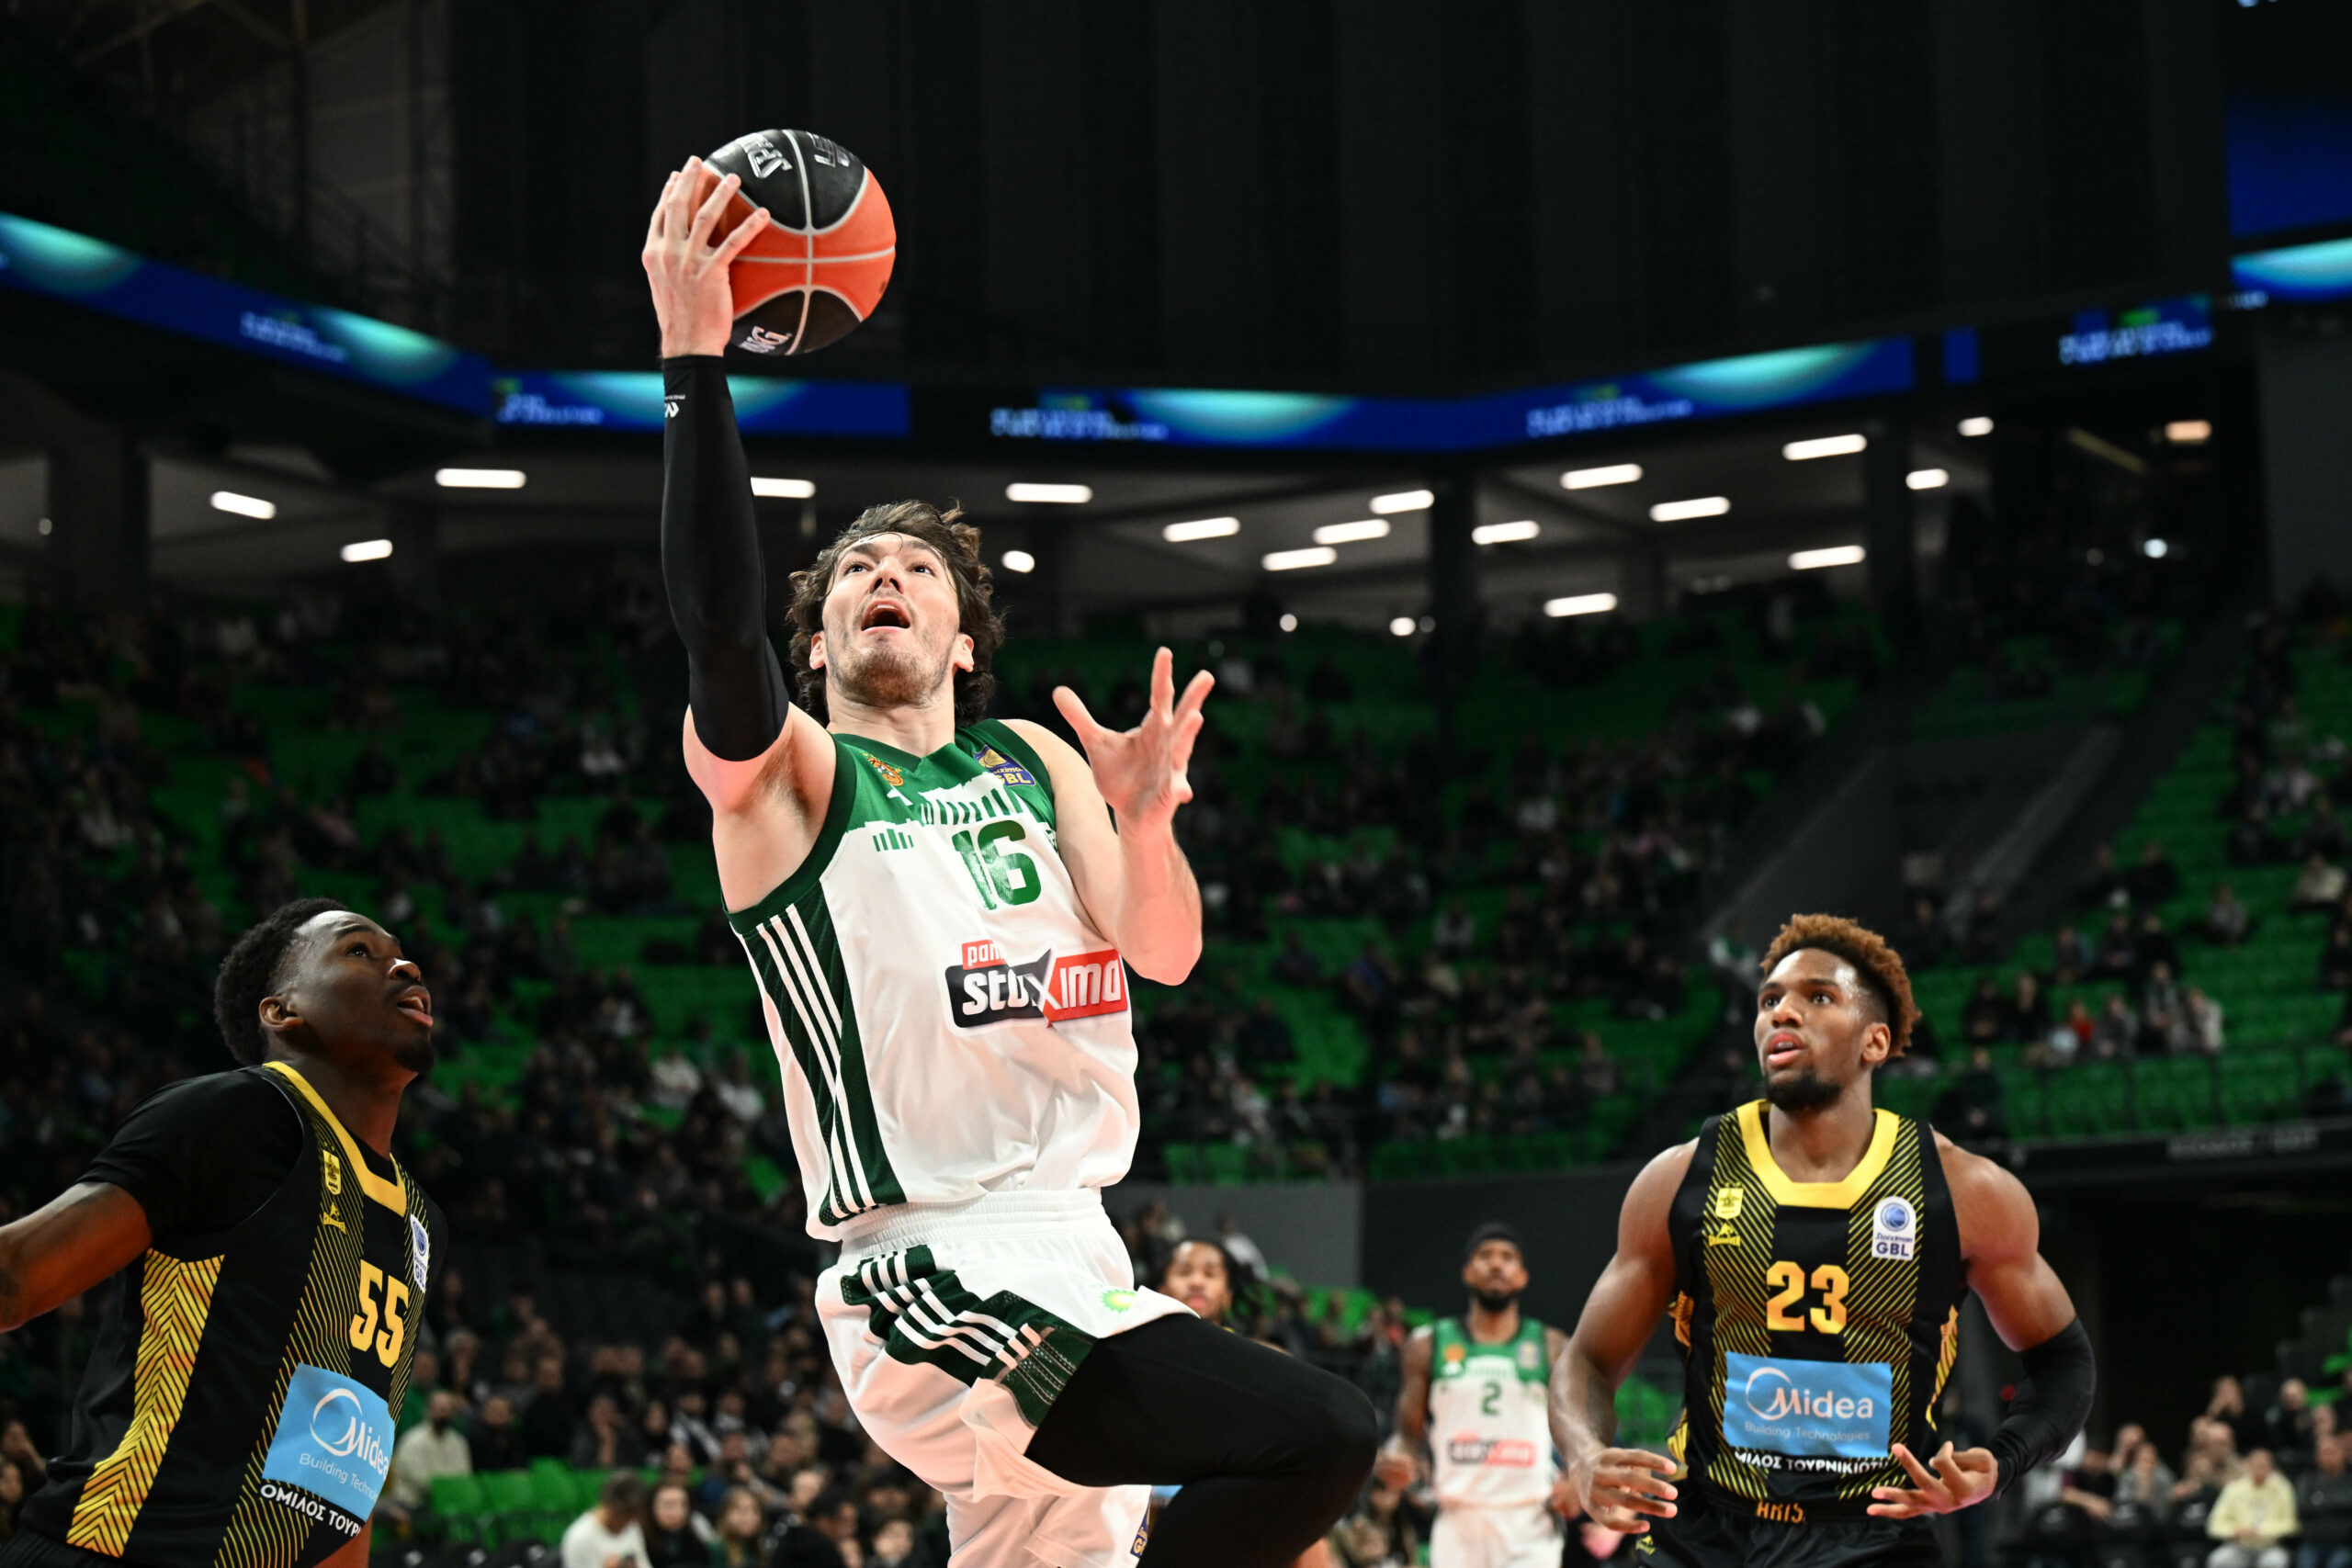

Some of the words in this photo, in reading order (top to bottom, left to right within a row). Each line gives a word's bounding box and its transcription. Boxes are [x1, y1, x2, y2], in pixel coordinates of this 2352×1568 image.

[952, 819, 1042, 910] 16
[1876, 1241, 1910, 1257] GBL
[348, 1258, 410, 1369] 55
[1766, 1260, 1850, 1335] 23
[1480, 1381, 1502, 1416] 2
[1757, 1382, 1873, 1420] Midea
[323, 1405, 390, 1481] Midea
[1745, 1421, 1792, 1438] Building
[1794, 1427, 1871, 1442] Technologies
[300, 1453, 348, 1483] Building
[260, 1483, 326, 1521] ΟΜΙΛΟΣ
